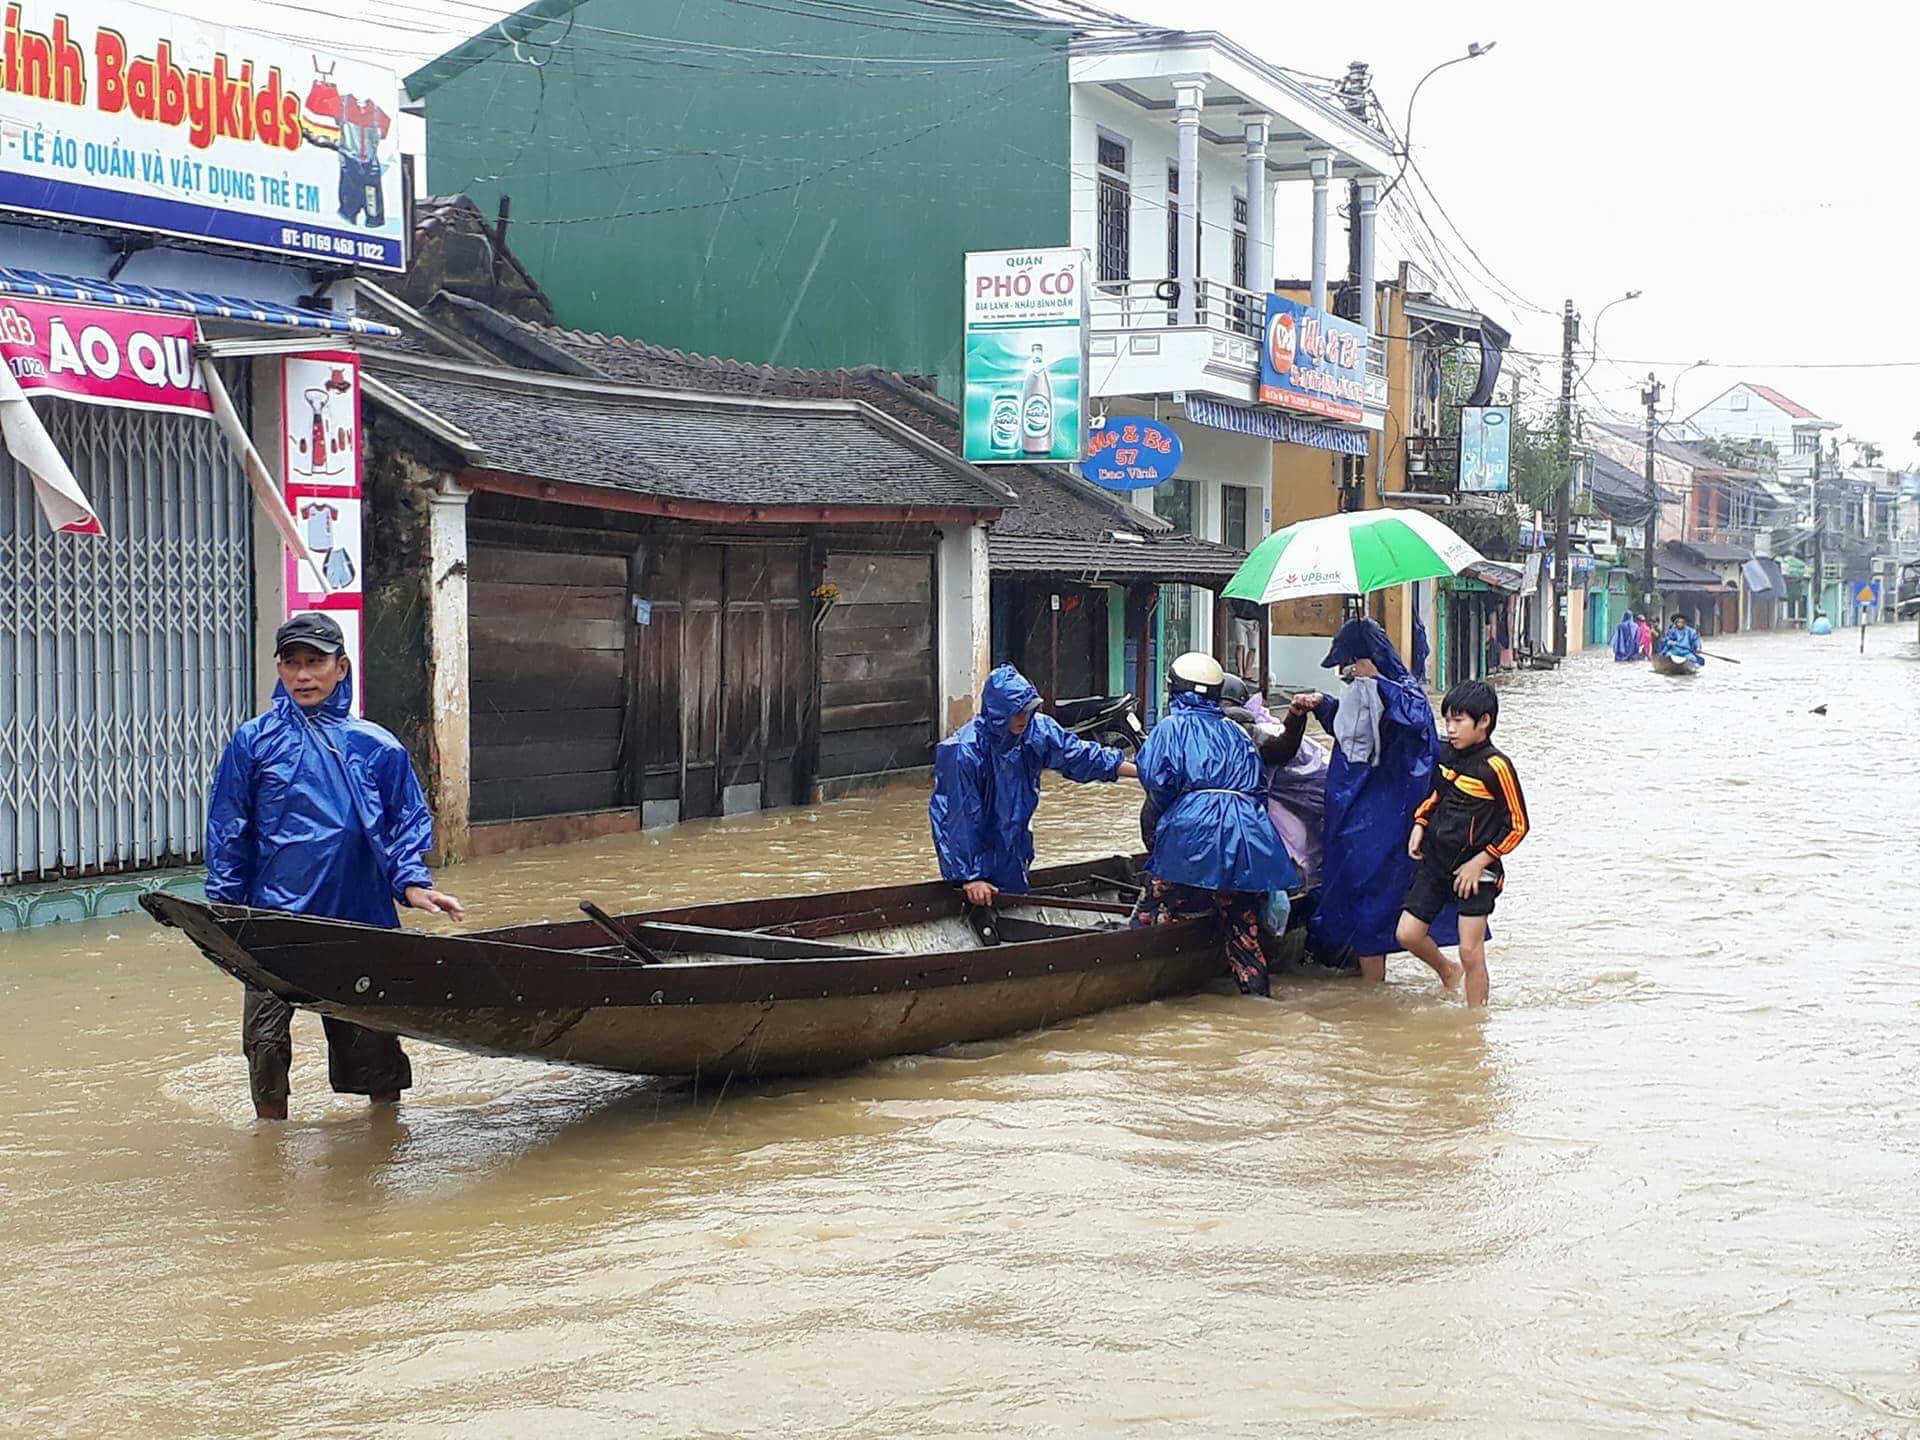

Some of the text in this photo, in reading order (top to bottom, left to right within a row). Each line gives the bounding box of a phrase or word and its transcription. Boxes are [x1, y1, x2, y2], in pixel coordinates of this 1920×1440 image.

[0, 2, 302, 151] inh Babykids
[23, 122, 45, 163] LẺ
[52, 130, 77, 169] ÁO
[142, 149, 165, 184] VÀ
[171, 155, 202, 196] VẬT
[208, 166, 256, 203] DỤNG
[261, 170, 290, 208] TRẺ
[296, 183, 321, 213] EM
[302, 232, 331, 251] 0169
[333, 237, 355, 255] 468
[357, 242, 384, 260] 1022
[976, 264, 1074, 298] PHỐ CỔ
[0, 306, 35, 345] ids
[49, 315, 121, 381] ÁO
[1122, 426, 1140, 444] &
[1114, 448, 1138, 465] 57
[1301, 570, 1341, 583] VPBank
